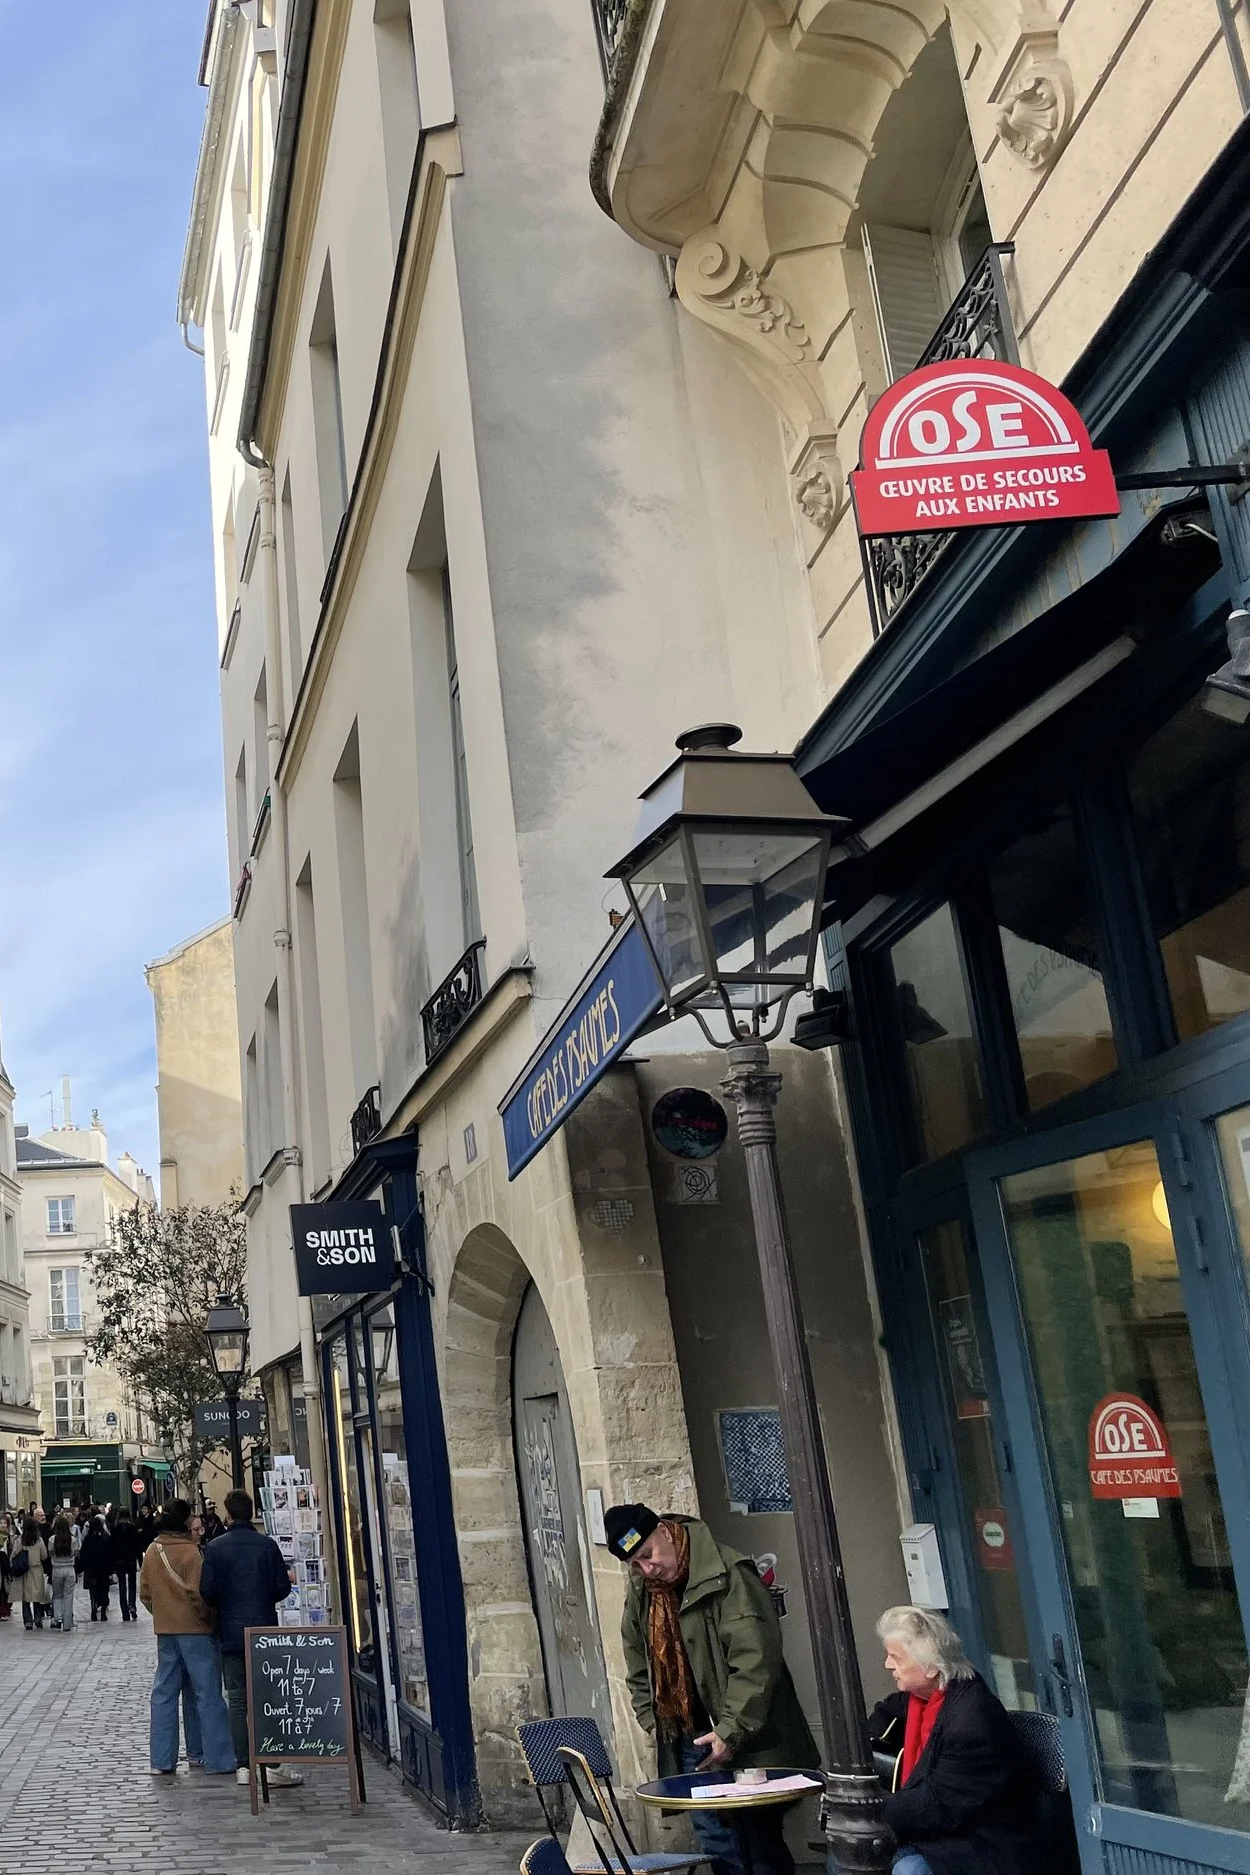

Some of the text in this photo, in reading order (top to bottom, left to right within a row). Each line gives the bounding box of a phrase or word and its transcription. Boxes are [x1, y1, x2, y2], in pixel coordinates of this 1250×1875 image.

[908, 390, 1030, 455] OSE
[879, 465, 1087, 498] ŒUVRE DE SECOURS
[915, 490, 1060, 518] AUX ENFANTS
[546, 1049, 568, 1118] DES
[566, 979, 621, 1095] PSAUMES
[465, 1129, 475, 1159] 18
[305, 1228, 374, 1248] SMITH
[316, 1246, 377, 1266] &SON
[1104, 1413, 1148, 1452] OSE
[1114, 1470, 1133, 1484] DES
[1134, 1467, 1178, 1484] PSAUMES
[255, 1635, 334, 1648] Smith & Son
[262, 1660, 283, 1682] Open
[282, 1655, 291, 1674] 7
[277, 1679, 289, 1696] 11
[292, 1683, 303, 1695] to
[306, 1678, 315, 1695] 7
[264, 1701, 292, 1716] Ouvert
[294, 1698, 304, 1715] 7
[331, 1697, 342, 1715] 7
[259, 1737, 284, 1752] Have
[298, 1738, 324, 1755] lovely
[327, 1738, 346, 1757] day
